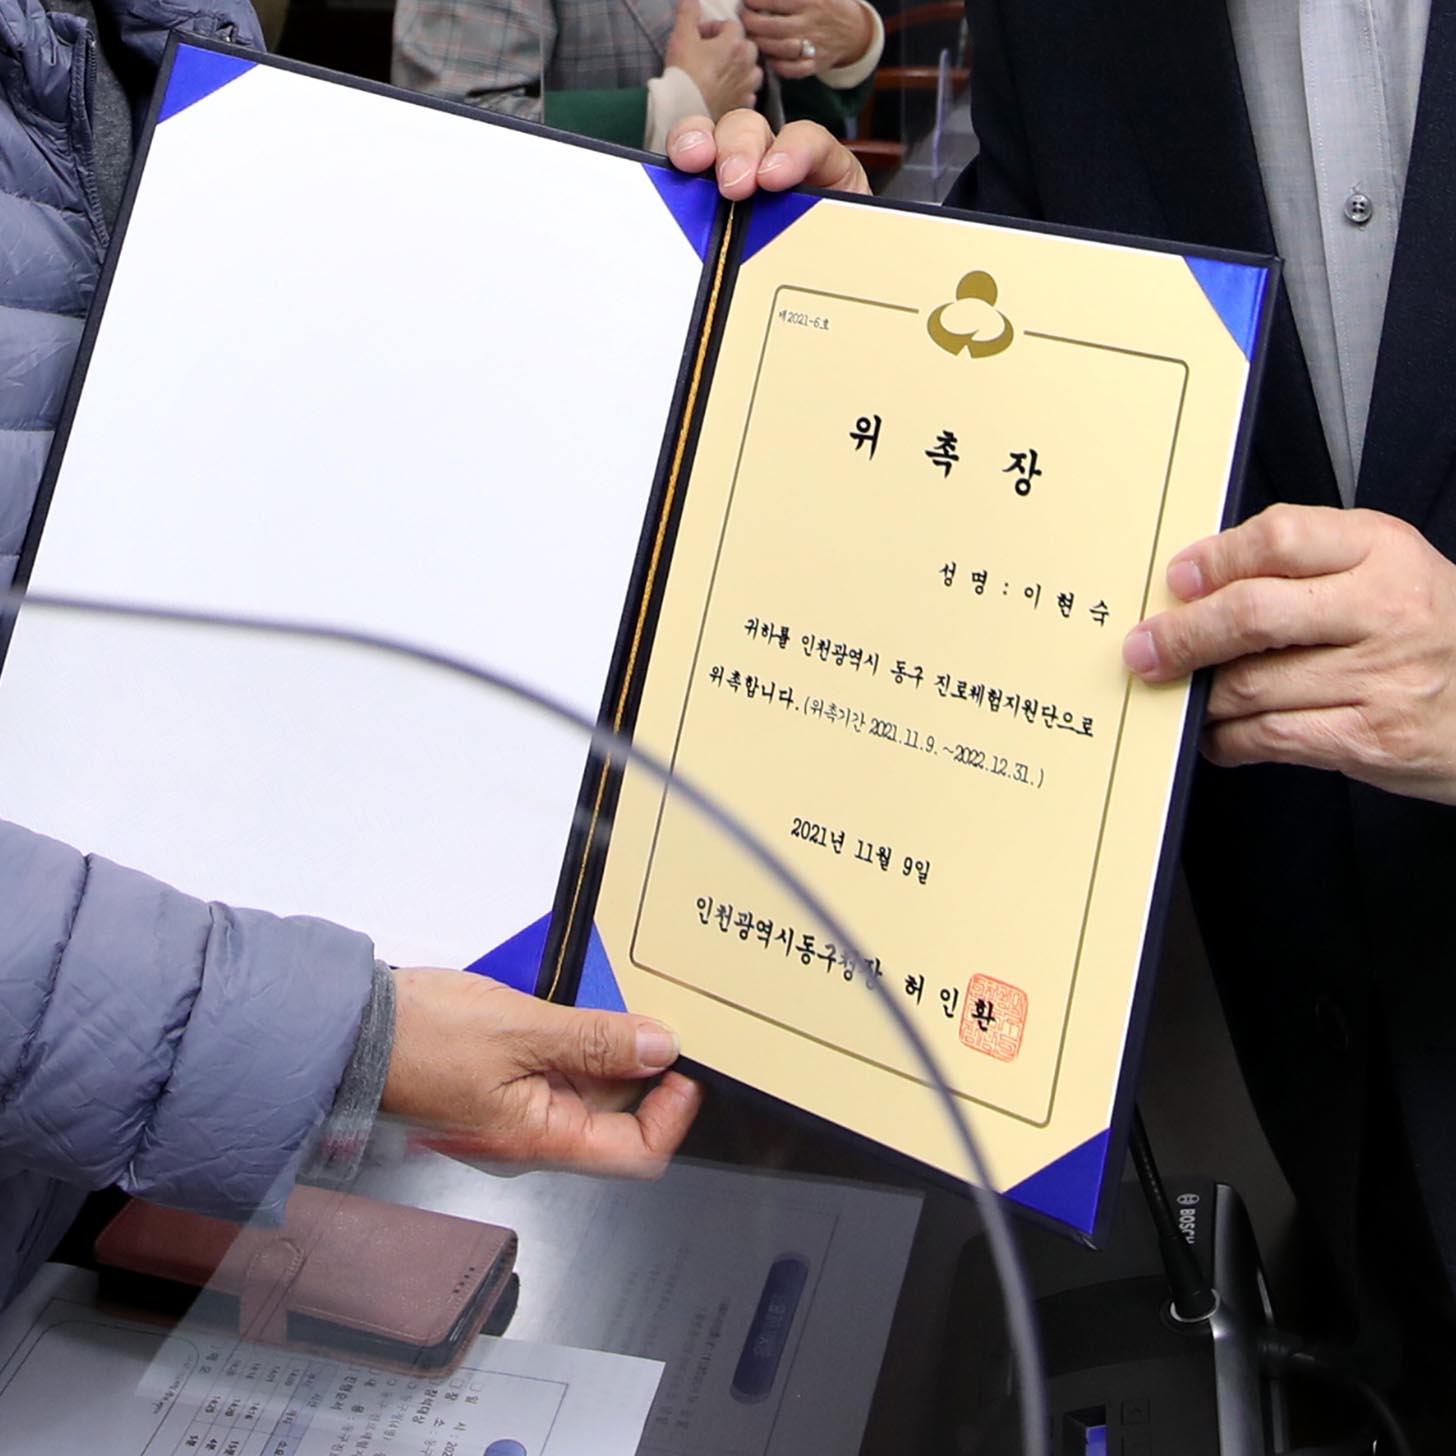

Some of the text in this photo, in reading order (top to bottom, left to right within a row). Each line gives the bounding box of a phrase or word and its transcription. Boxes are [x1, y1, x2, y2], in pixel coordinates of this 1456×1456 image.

[744, 617, 1094, 738] 귀하를 인천광역시 동구 진로체험지원단으로
[790, 817, 931, 885] 2021년 11월 9일
